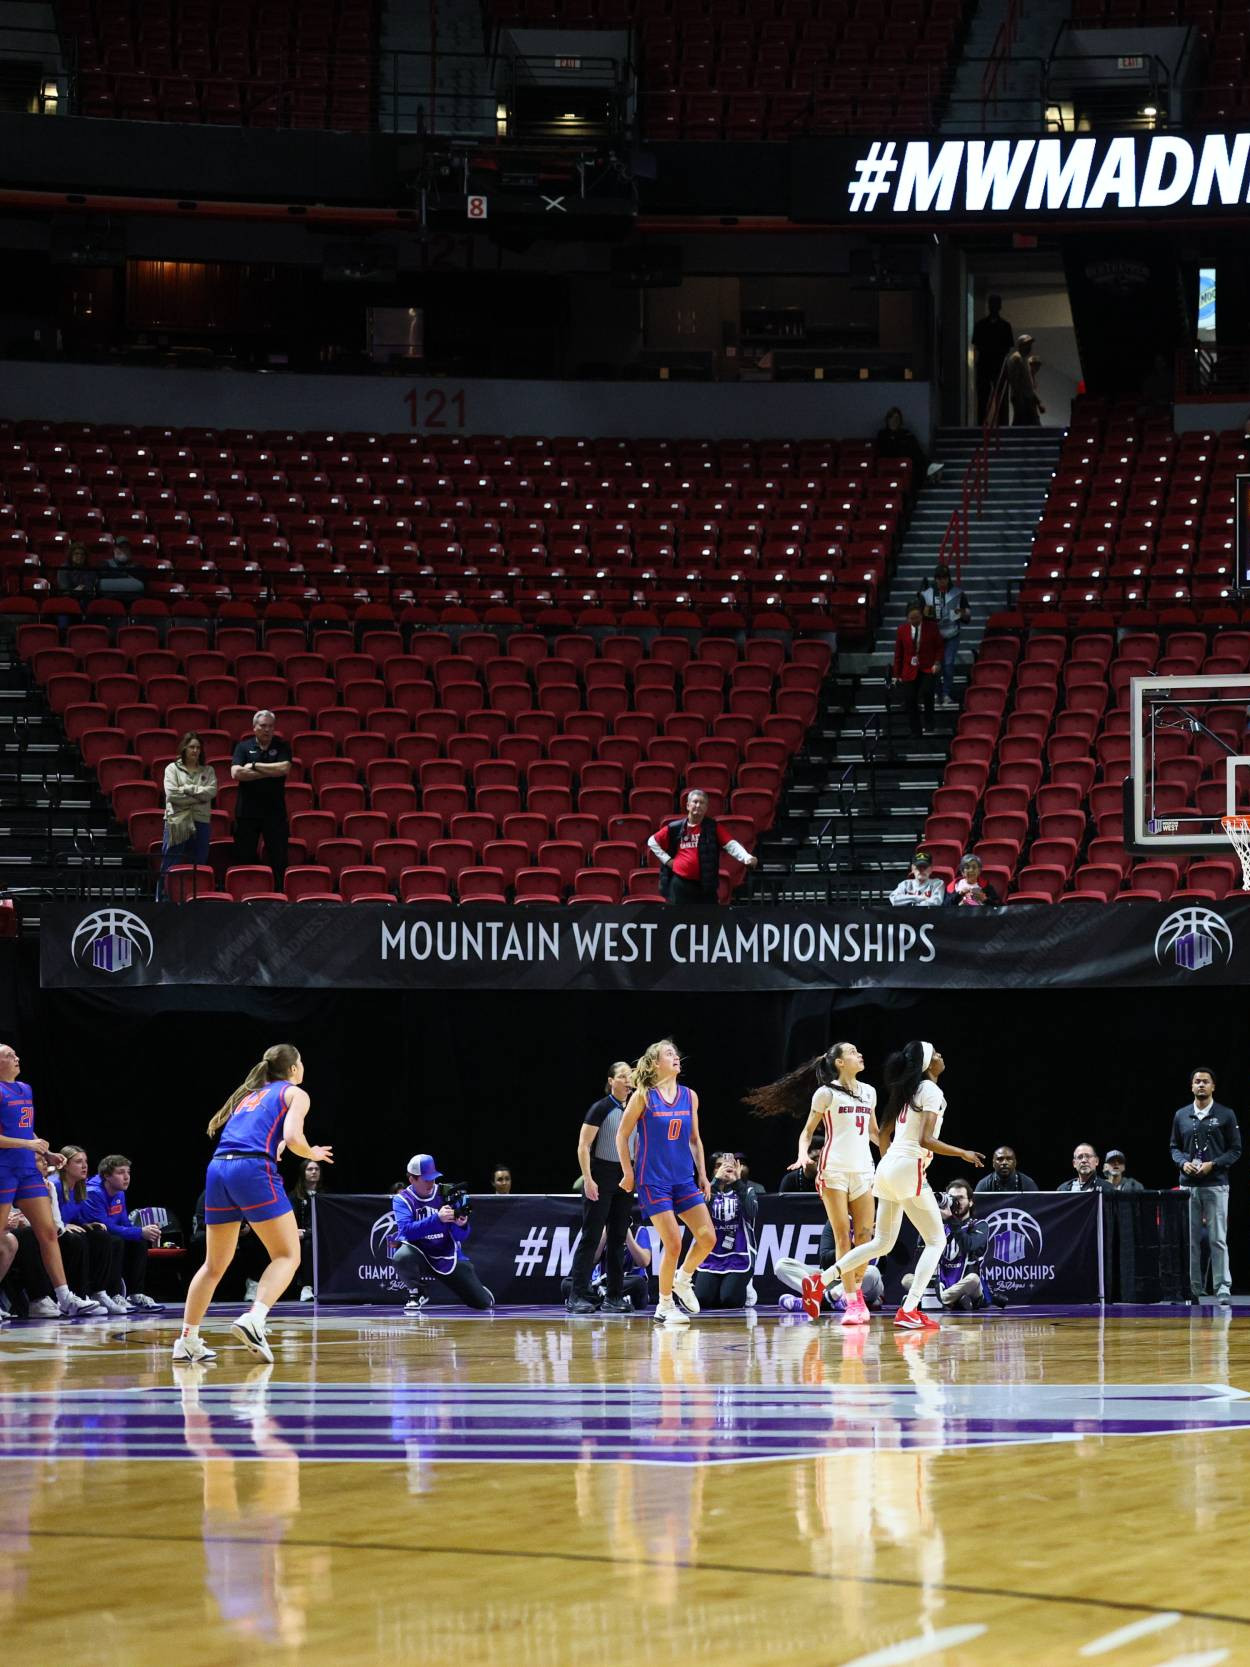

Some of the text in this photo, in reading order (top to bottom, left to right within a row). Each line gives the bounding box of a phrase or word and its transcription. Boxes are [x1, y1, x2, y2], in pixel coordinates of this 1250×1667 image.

[472, 199, 483, 215] 8
[404, 389, 465, 428] 121
[381, 919, 560, 962] MOUNTAIN
[572, 922, 659, 962] WEST
[670, 922, 937, 964] CHAMPIONSHIPS
[668, 1119, 682, 1141] 0
[855, 1116, 865, 1136] 4
